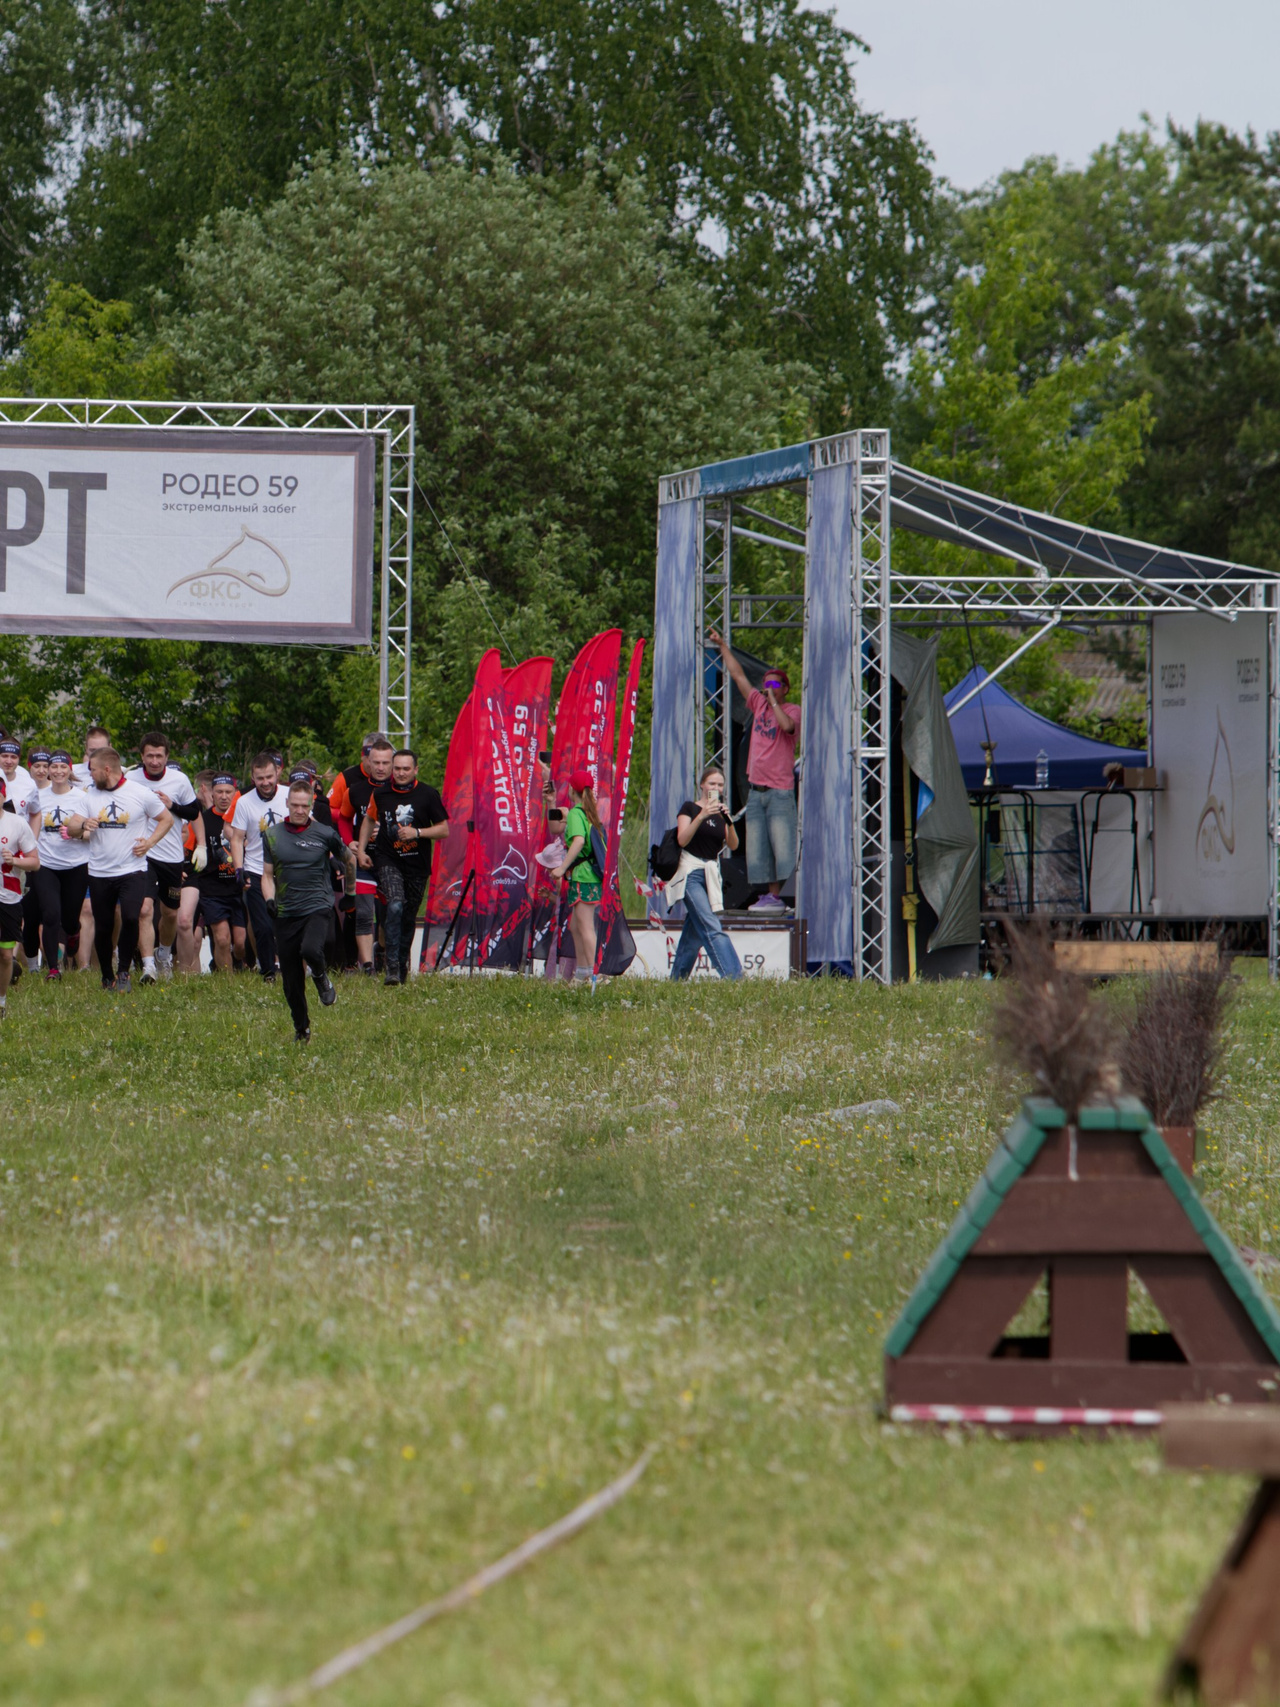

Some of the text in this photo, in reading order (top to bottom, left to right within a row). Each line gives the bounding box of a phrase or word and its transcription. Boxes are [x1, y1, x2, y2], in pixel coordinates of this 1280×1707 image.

[162, 473, 299, 499] РОДЕО 59
[162, 502, 297, 514] экстремальный забег
[189, 580, 242, 600] ФКС
[743, 954, 765, 970] 59
